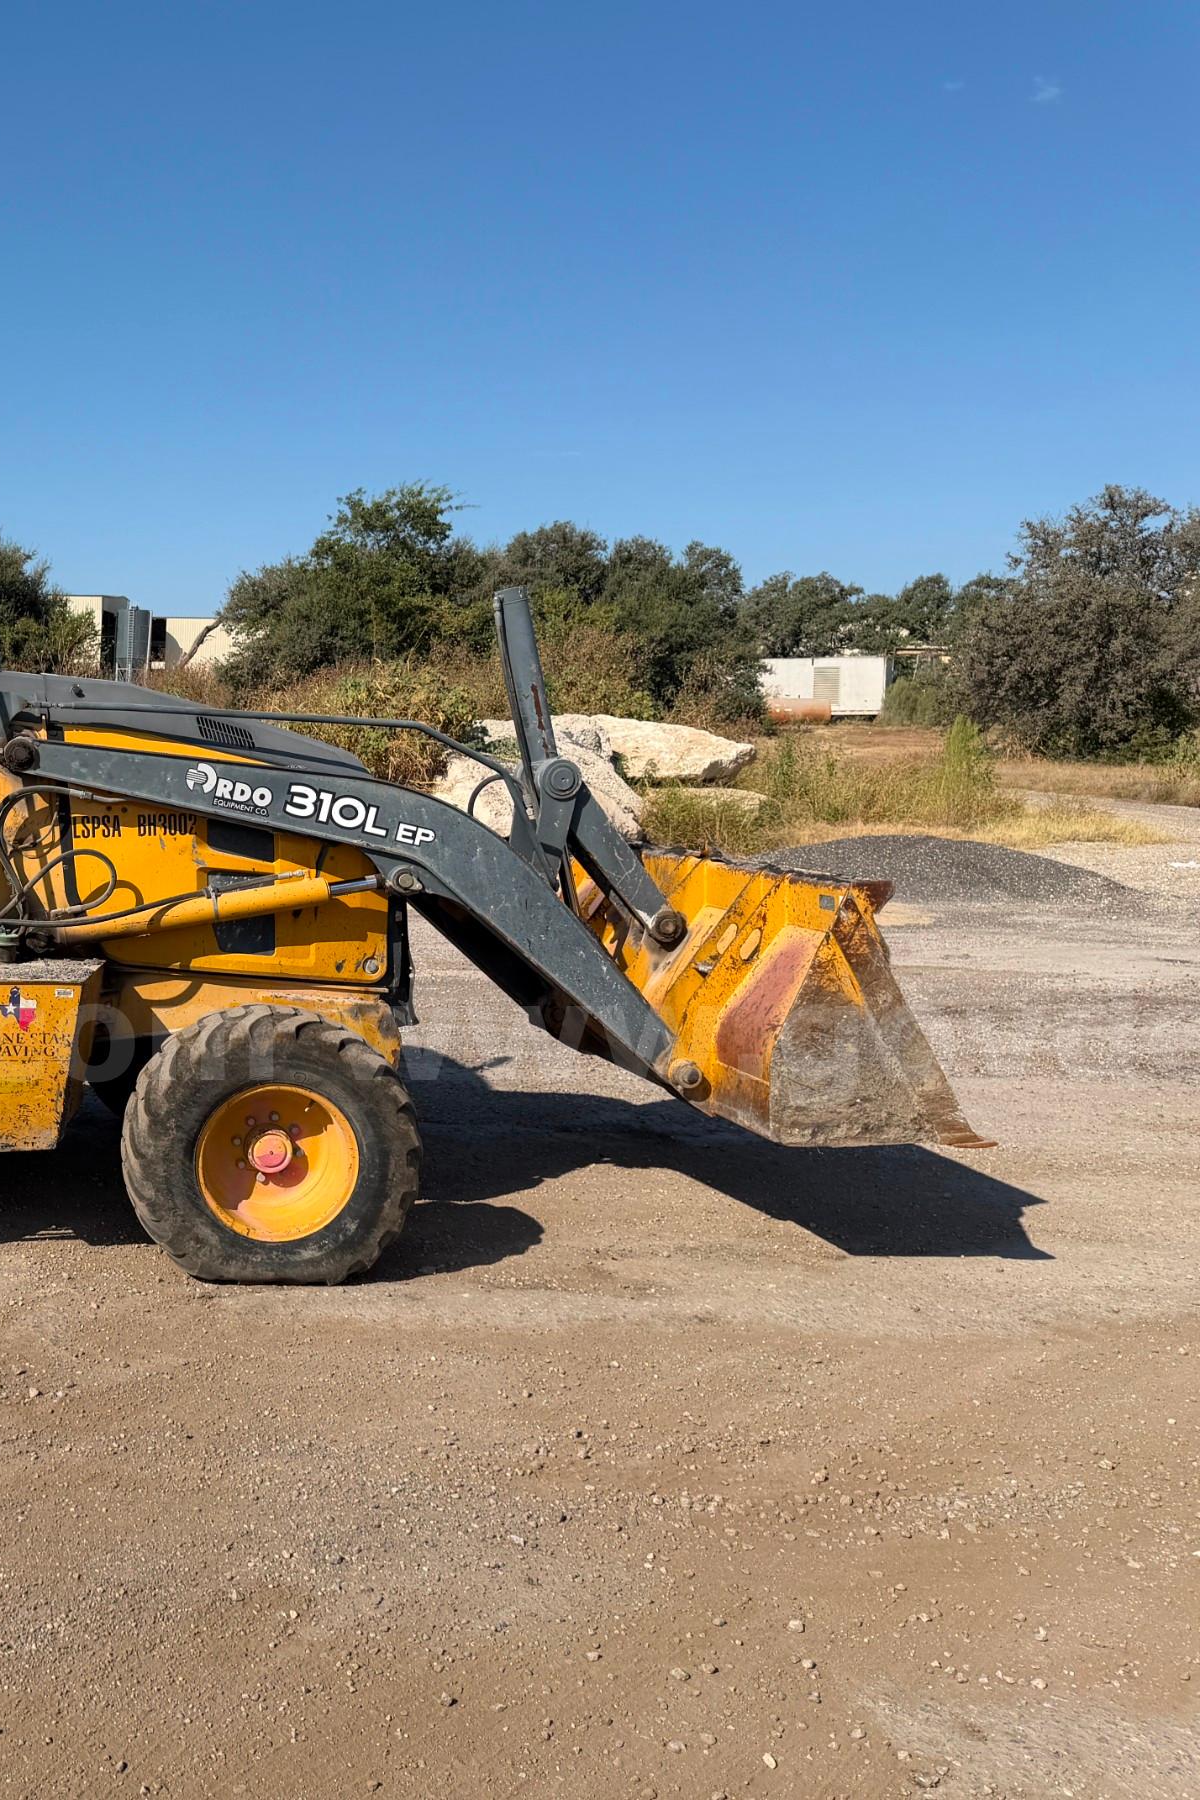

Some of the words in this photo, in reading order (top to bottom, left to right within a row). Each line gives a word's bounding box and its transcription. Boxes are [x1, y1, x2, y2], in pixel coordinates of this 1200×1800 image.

[213, 798, 254, 815] EQUIPMENT
[254, 807, 270, 818] CO.
[284, 783, 388, 838] 310L
[395, 822, 436, 848] EP
[72, 815, 122, 839] LSPSA
[137, 813, 198, 837] BH3002
